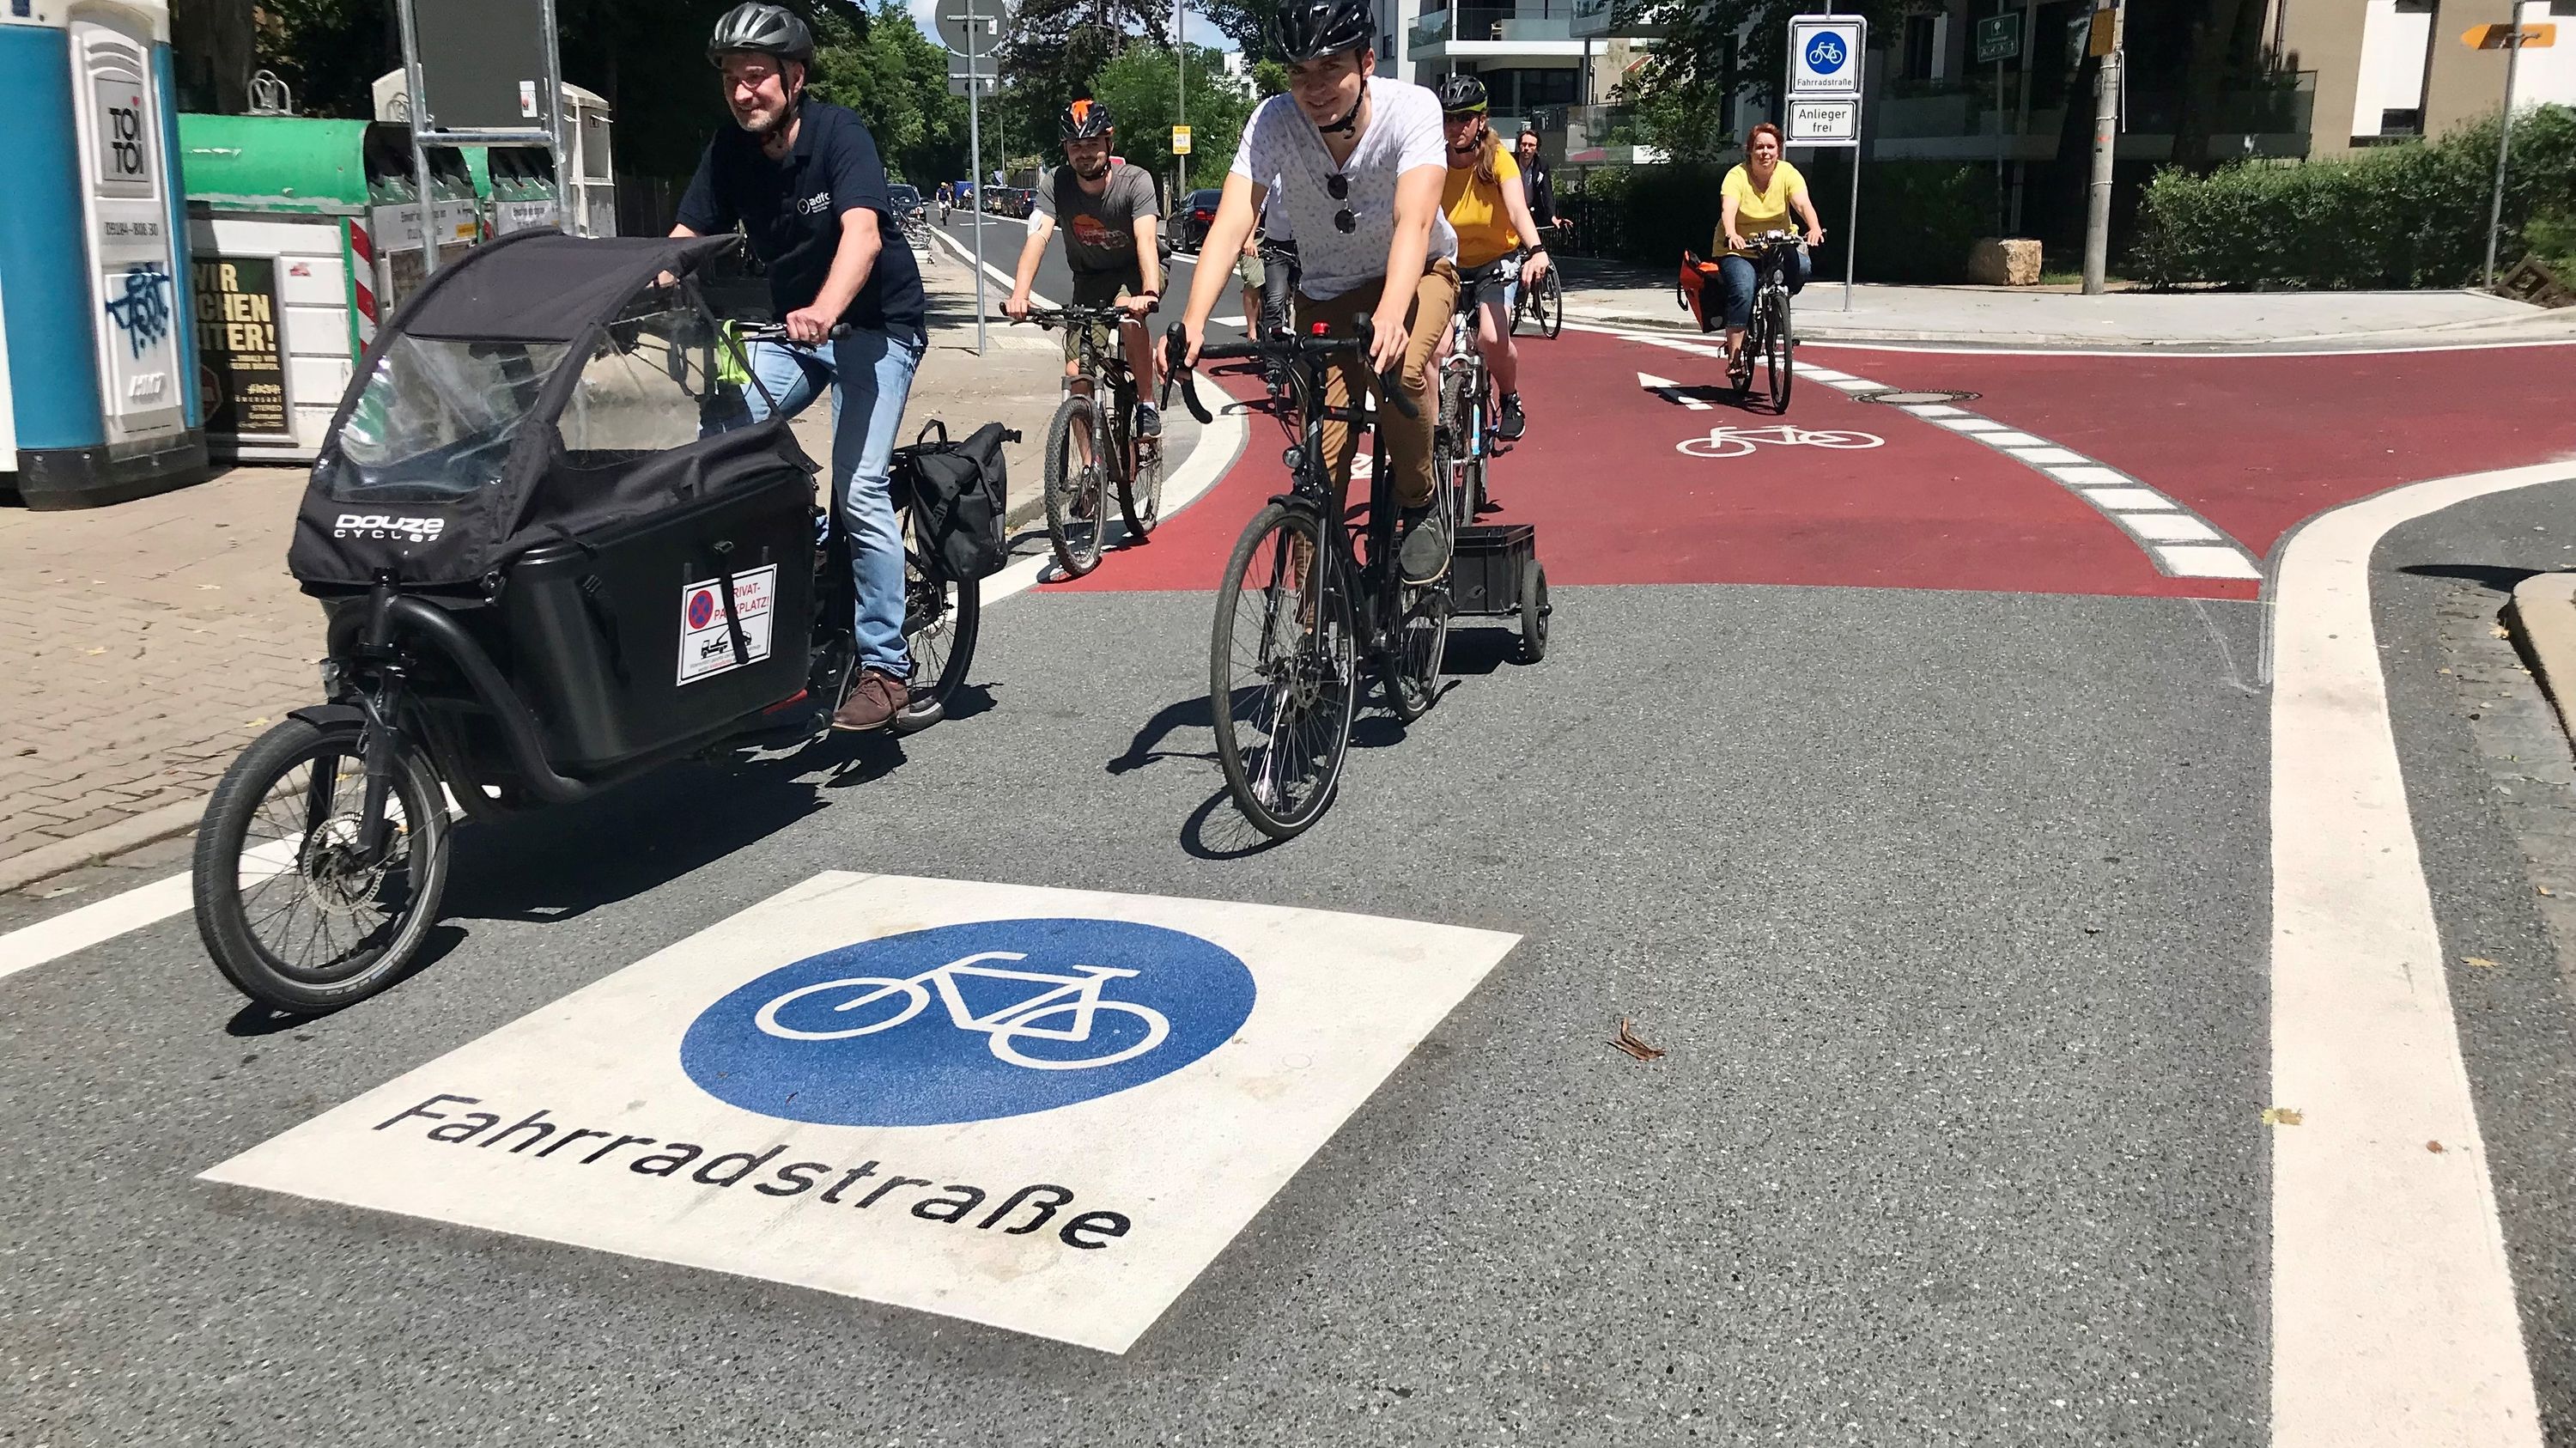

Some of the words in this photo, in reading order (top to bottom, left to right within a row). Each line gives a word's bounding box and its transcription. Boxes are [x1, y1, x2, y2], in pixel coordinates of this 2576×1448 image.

[108, 107, 142, 141] TOI
[1798, 108, 1847, 121] Anlieger
[1813, 122, 1832, 132] frei
[111, 141, 144, 174] TOI
[808, 192, 830, 206] adfc
[197, 293, 270, 322] CHEN
[733, 582, 761, 598] RIVAT-
[714, 596, 769, 620] PAPLATZ!
[371, 1092, 1132, 1250] Fahrradstraße
